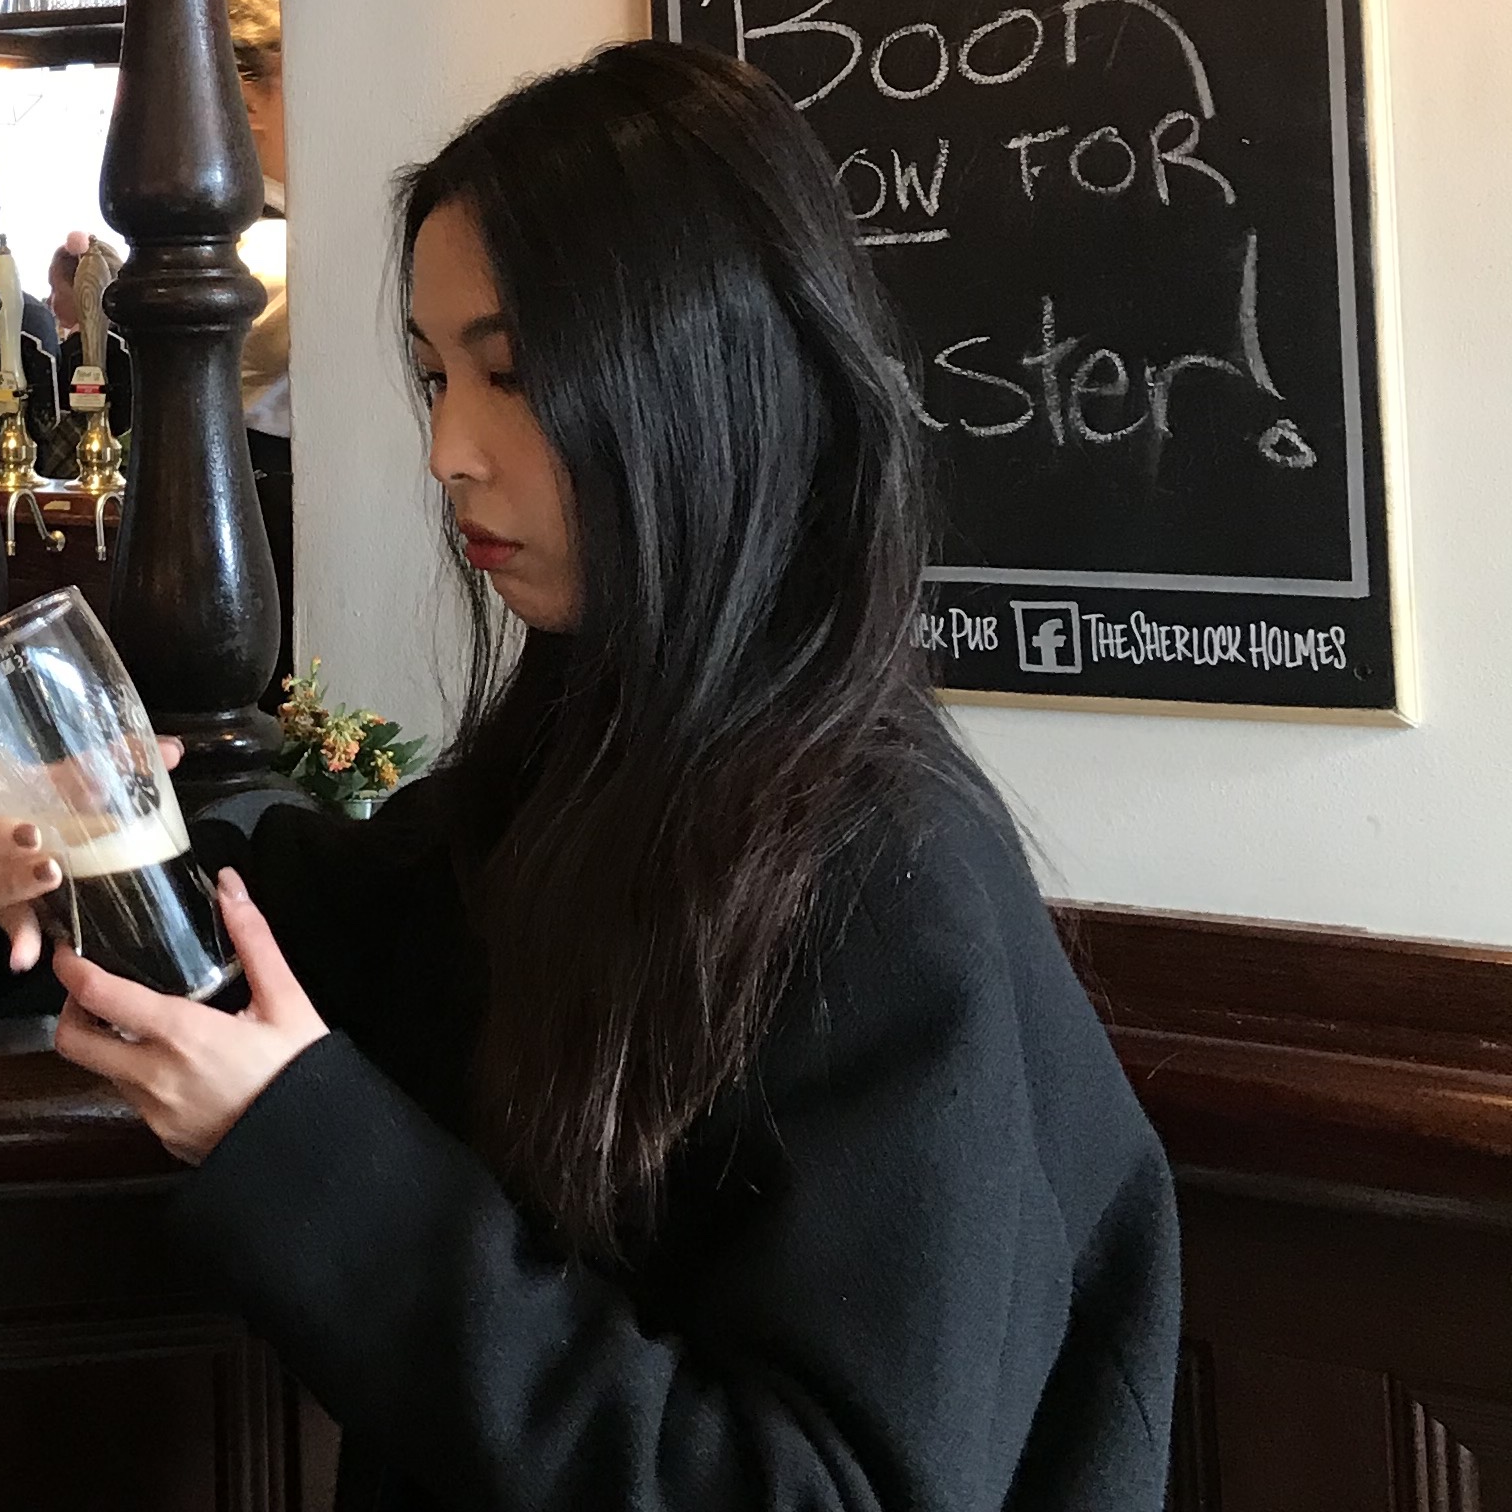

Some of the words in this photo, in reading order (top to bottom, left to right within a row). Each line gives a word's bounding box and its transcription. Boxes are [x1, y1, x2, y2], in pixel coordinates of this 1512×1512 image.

[835, 138, 949, 220] OW
[1002, 110, 1236, 206] FOR
[897, 228, 1317, 468] ster!
